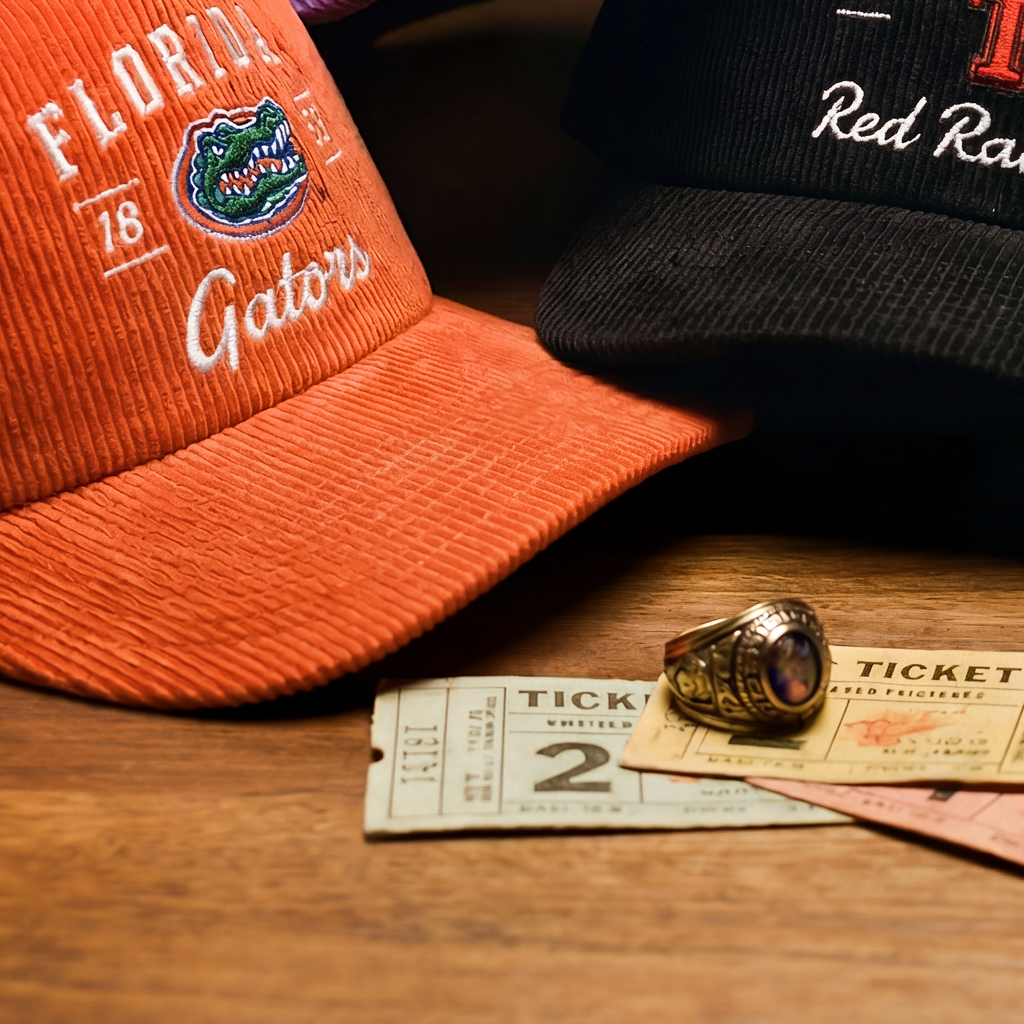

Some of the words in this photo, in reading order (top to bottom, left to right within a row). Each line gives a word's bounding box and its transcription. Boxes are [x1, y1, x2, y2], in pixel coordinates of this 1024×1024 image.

[27, 2, 282, 182] FLORIDA
[811, 80, 927, 150] Red
[98, 201, 144, 254] 18
[186, 235, 372, 373] Gators
[856, 660, 1023, 684] TICKET
[518, 690, 652, 711] TICK
[534, 742, 612, 792] 2
